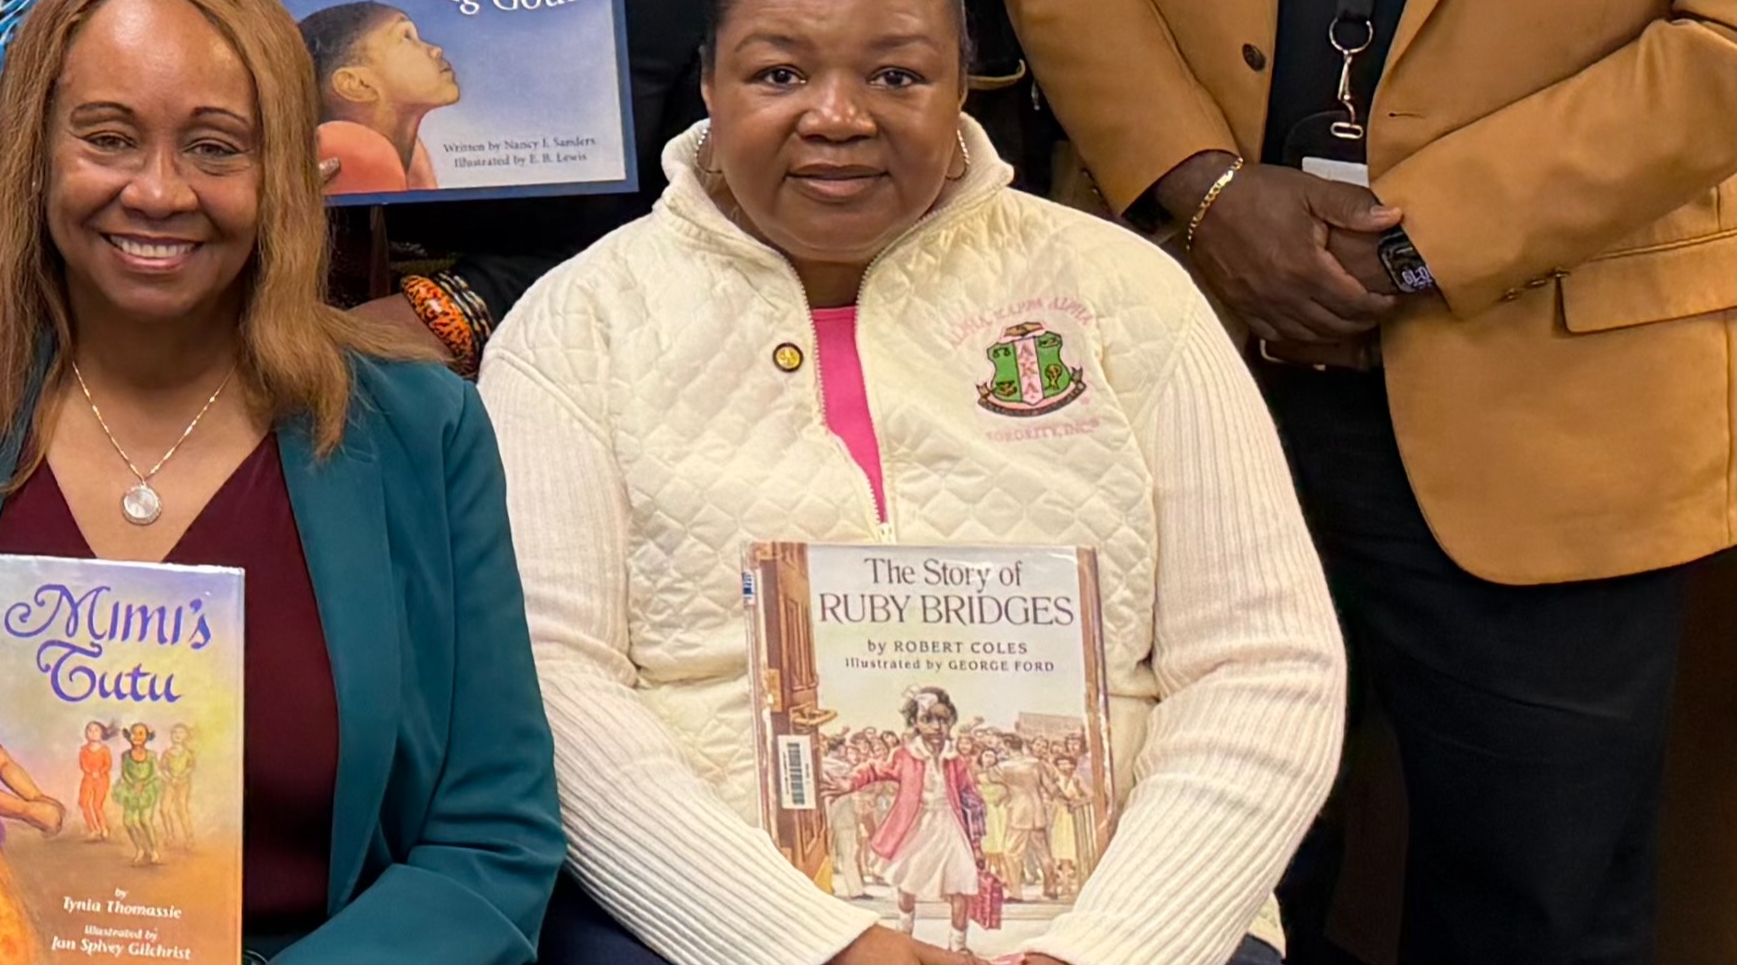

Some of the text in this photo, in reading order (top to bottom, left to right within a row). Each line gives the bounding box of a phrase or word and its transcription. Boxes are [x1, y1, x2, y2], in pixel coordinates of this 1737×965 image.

[488, 140, 502, 153] by
[553, 135, 598, 147] Sanders
[453, 154, 510, 168] Illustrated
[513, 154, 526, 166] by
[864, 557, 1024, 593] The Story of
[3, 583, 212, 650] Mimi's
[818, 593, 1075, 627] RUBY BRIDGES
[867, 639, 1029, 655] by ROBERT COLES
[36, 639, 182, 703] Tutu
[844, 658, 1055, 673] Illustrated by GEORGE FORD
[114, 887, 128, 900] by
[63, 896, 182, 919] Tynia Thomassie
[51, 936, 192, 961] Jan Spivey Gilchrist
